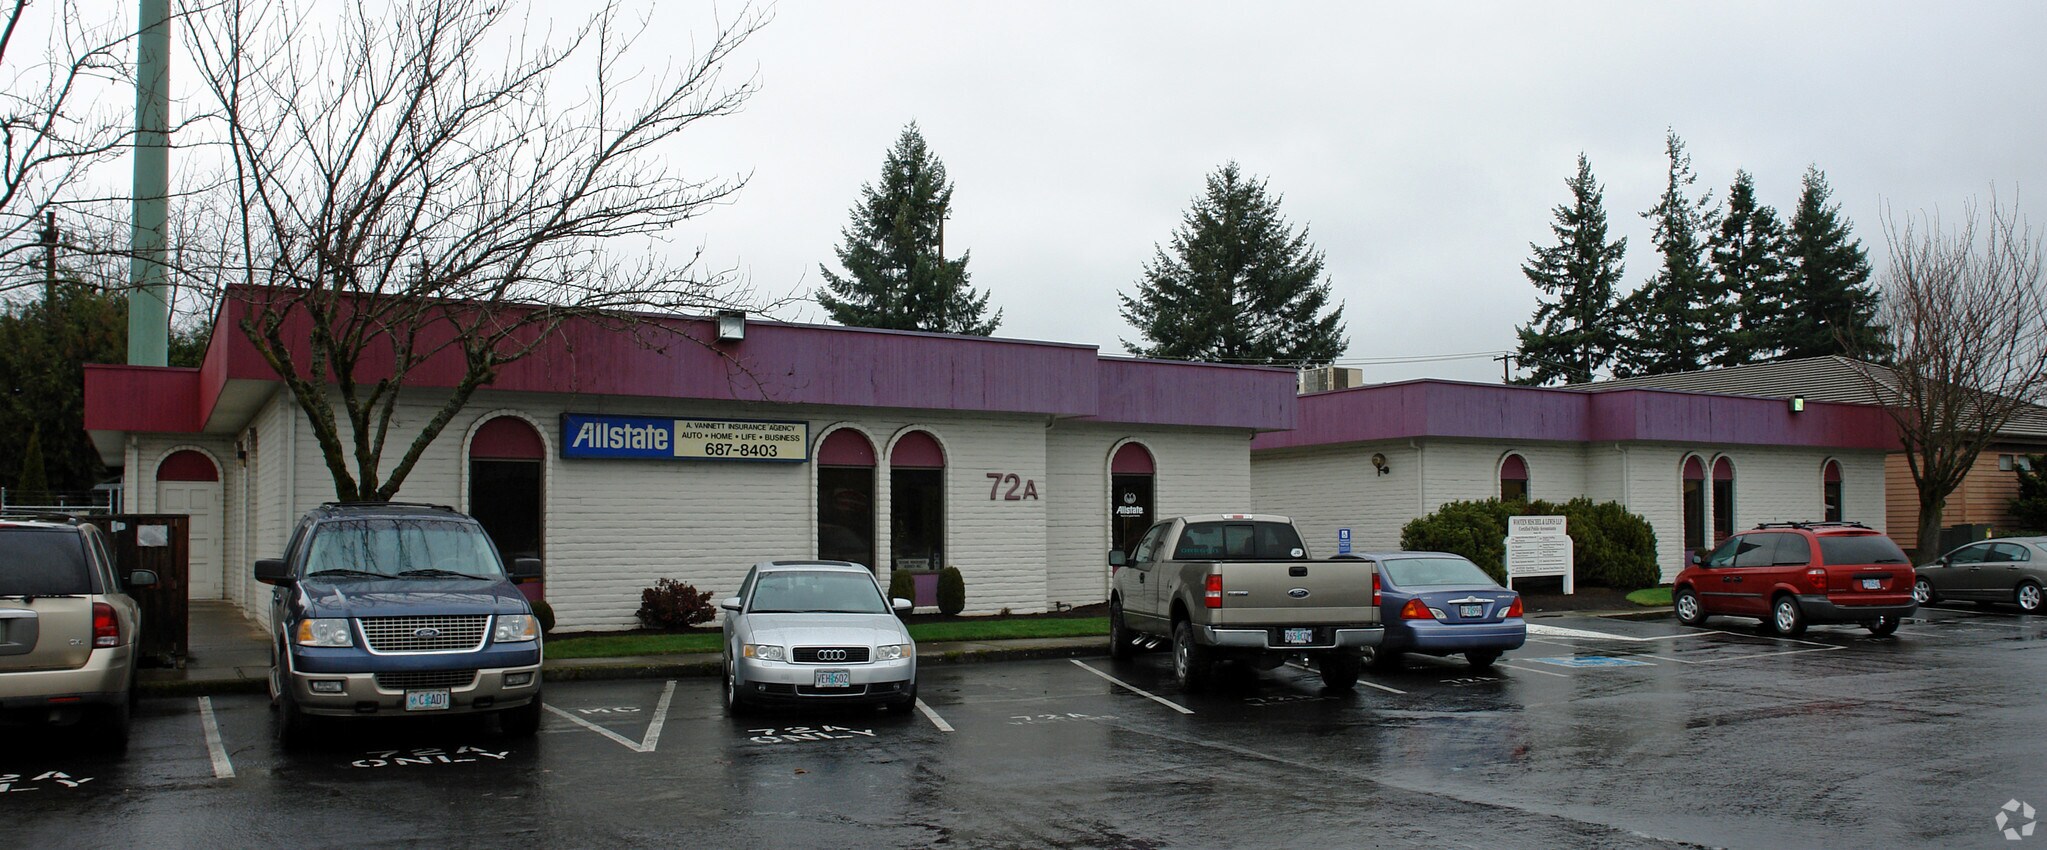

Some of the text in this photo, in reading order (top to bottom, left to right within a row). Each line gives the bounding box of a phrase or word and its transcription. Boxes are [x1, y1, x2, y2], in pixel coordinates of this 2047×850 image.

[694, 422, 725, 430] VANNETT
[572, 422, 668, 450] Allstate
[764, 434, 801, 442] BUSINESS
[705, 442, 778, 457] 687-8403
[986, 473, 1039, 501] 72A
[1116, 505, 1144, 515] Allstate
[817, 673, 849, 684] VEH 602
[750, 730, 876, 743] ONLY
[351, 751, 510, 767] ONLY
